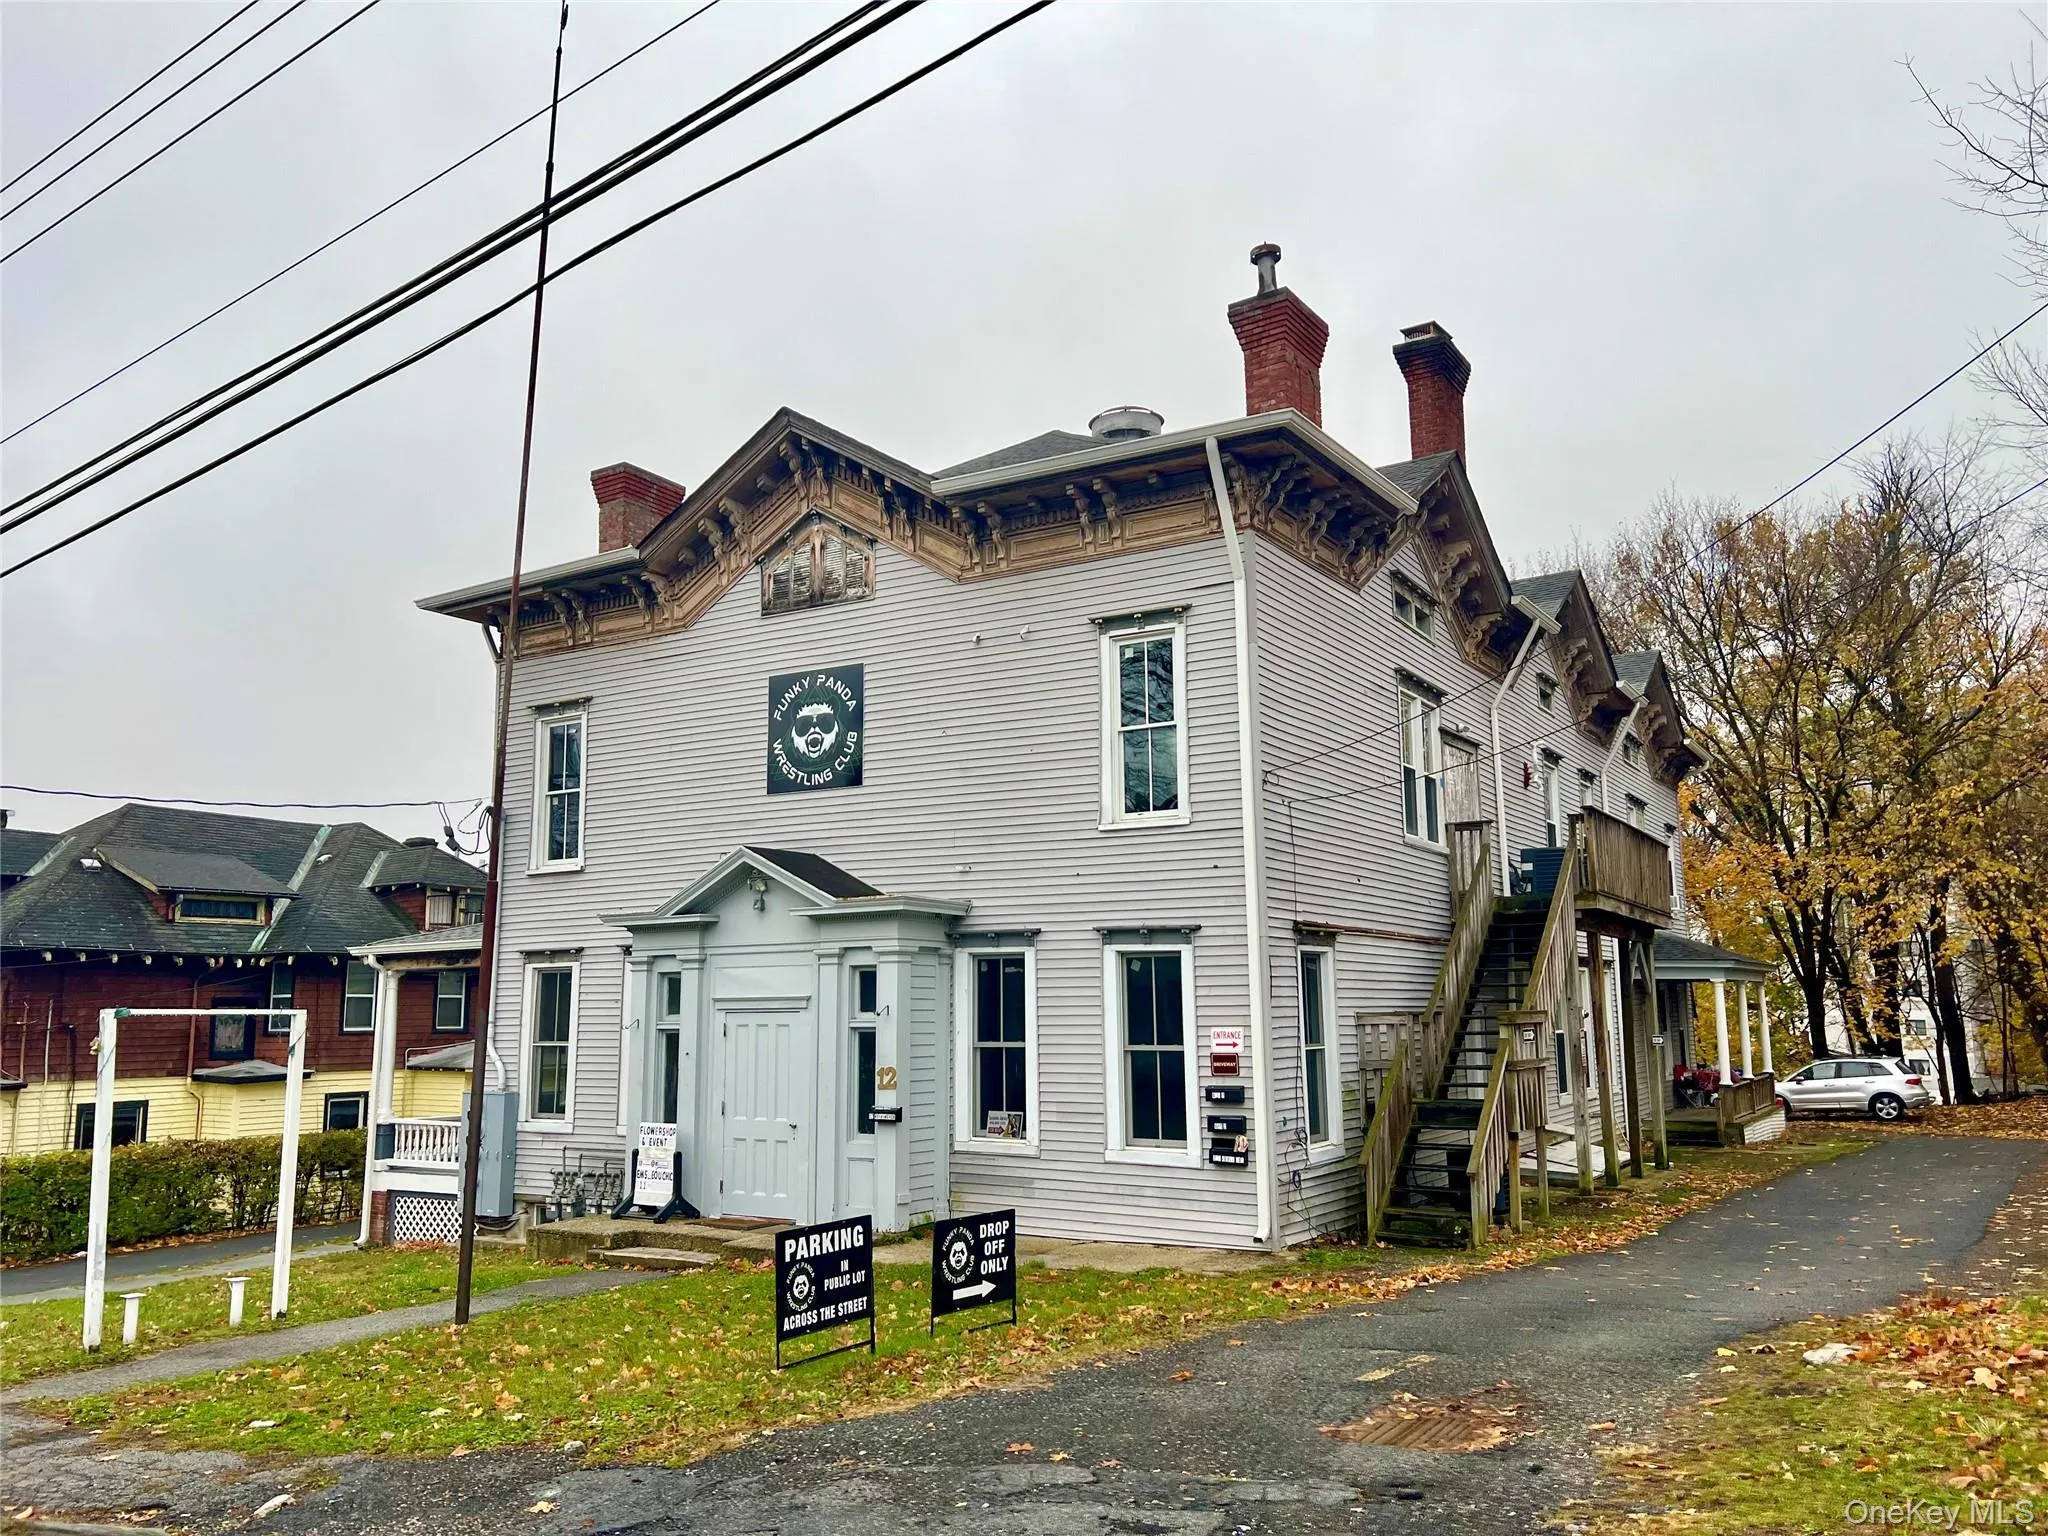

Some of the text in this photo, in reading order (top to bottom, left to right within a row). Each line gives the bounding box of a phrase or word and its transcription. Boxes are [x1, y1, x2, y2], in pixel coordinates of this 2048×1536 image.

[773, 674, 857, 721] FUNKY PANDA
[772, 731, 858, 786] WRESTLING CLUB
[1213, 1030, 1241, 1040] ENTRANCE
[877, 1066, 897, 1090] 12
[640, 1126, 676, 1137] FLOWERSHOP
[649, 1137, 667, 1147] EVENT
[979, 1220, 1010, 1239] DROP
[784, 1224, 864, 1263] PARKING
[984, 1239, 1005, 1256] OFF
[840, 1259, 849, 1272] IN
[980, 1256, 1009, 1275] ONLY
[824, 1270, 866, 1292] PUBLIC LOT
[783, 1296, 868, 1332] ACROSS THE STREET
